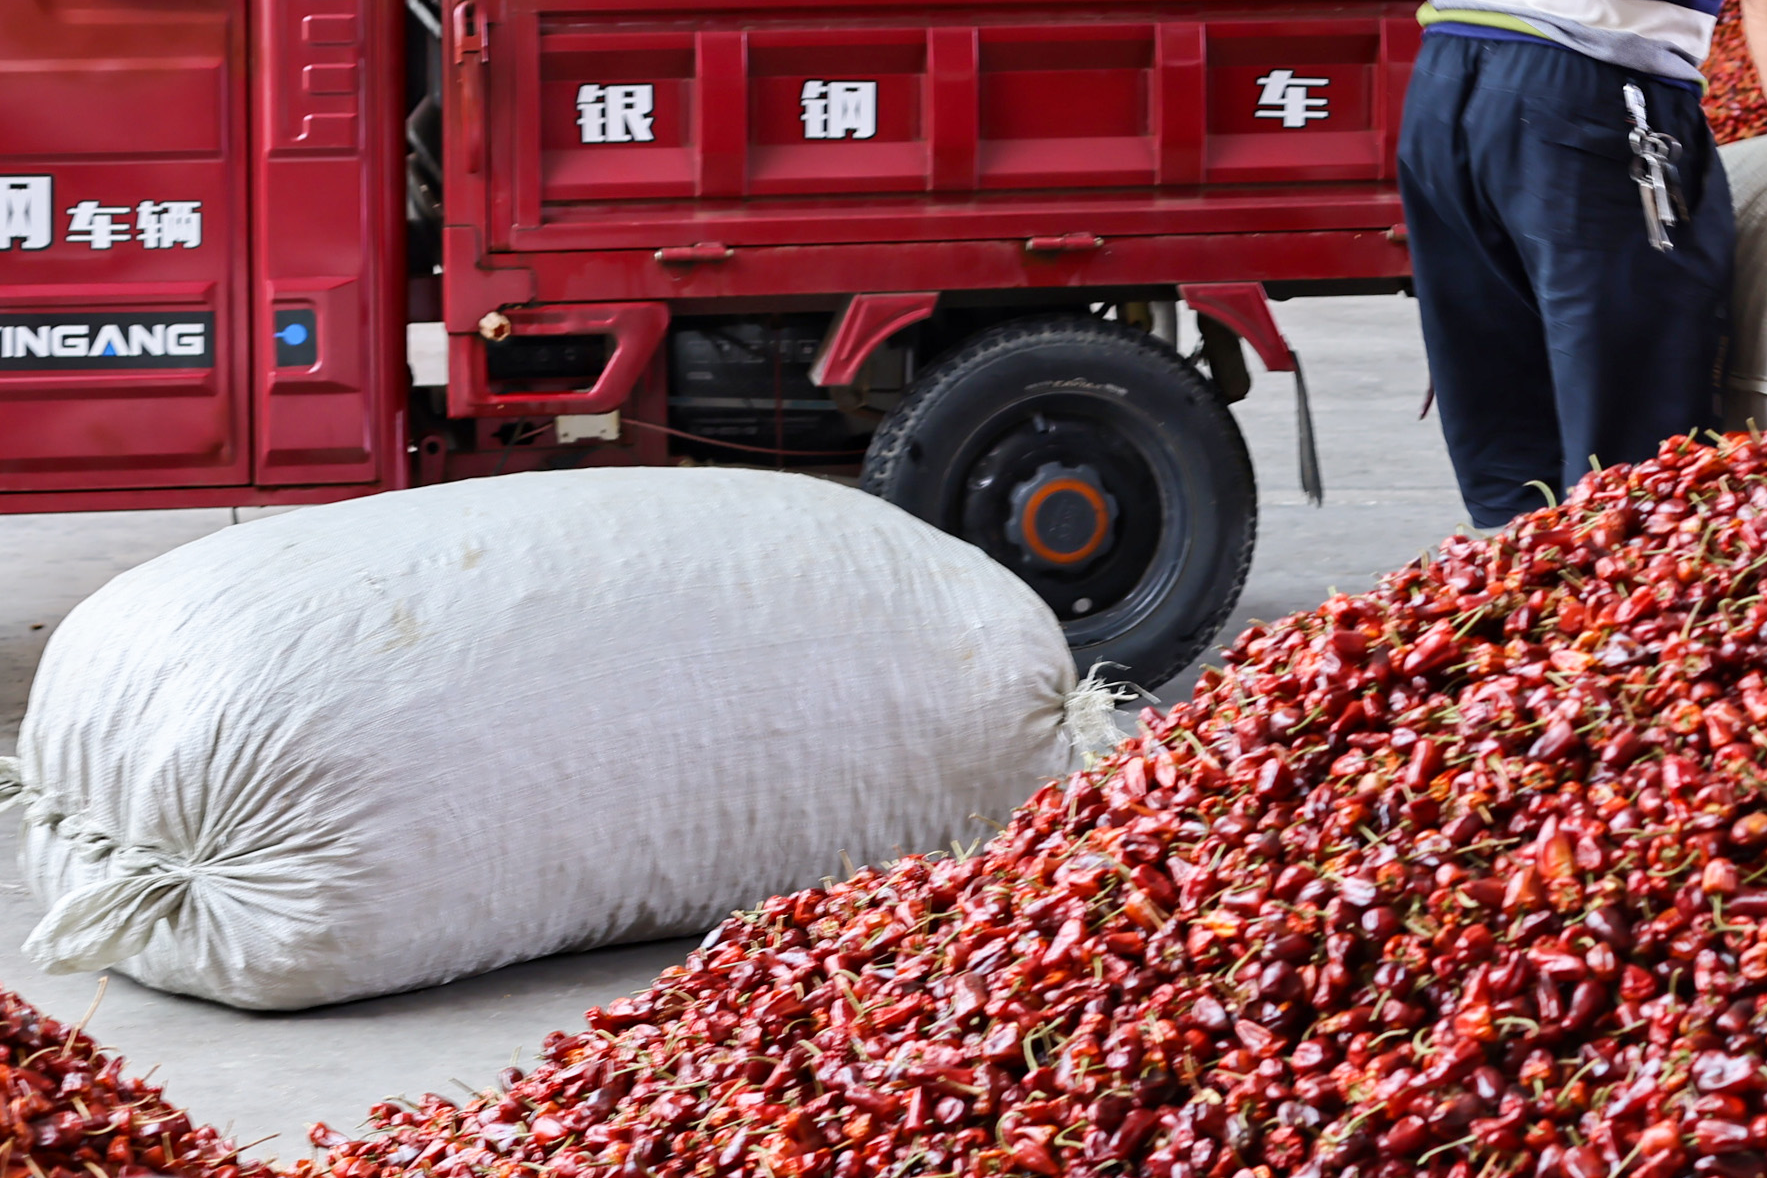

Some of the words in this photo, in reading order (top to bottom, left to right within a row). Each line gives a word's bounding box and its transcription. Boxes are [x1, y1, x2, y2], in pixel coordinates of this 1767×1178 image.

[576, 84, 655, 143] 银
[800, 80, 877, 139] 钢
[1254, 69, 1329, 128] 车
[0, 323, 205, 358] INGANG
